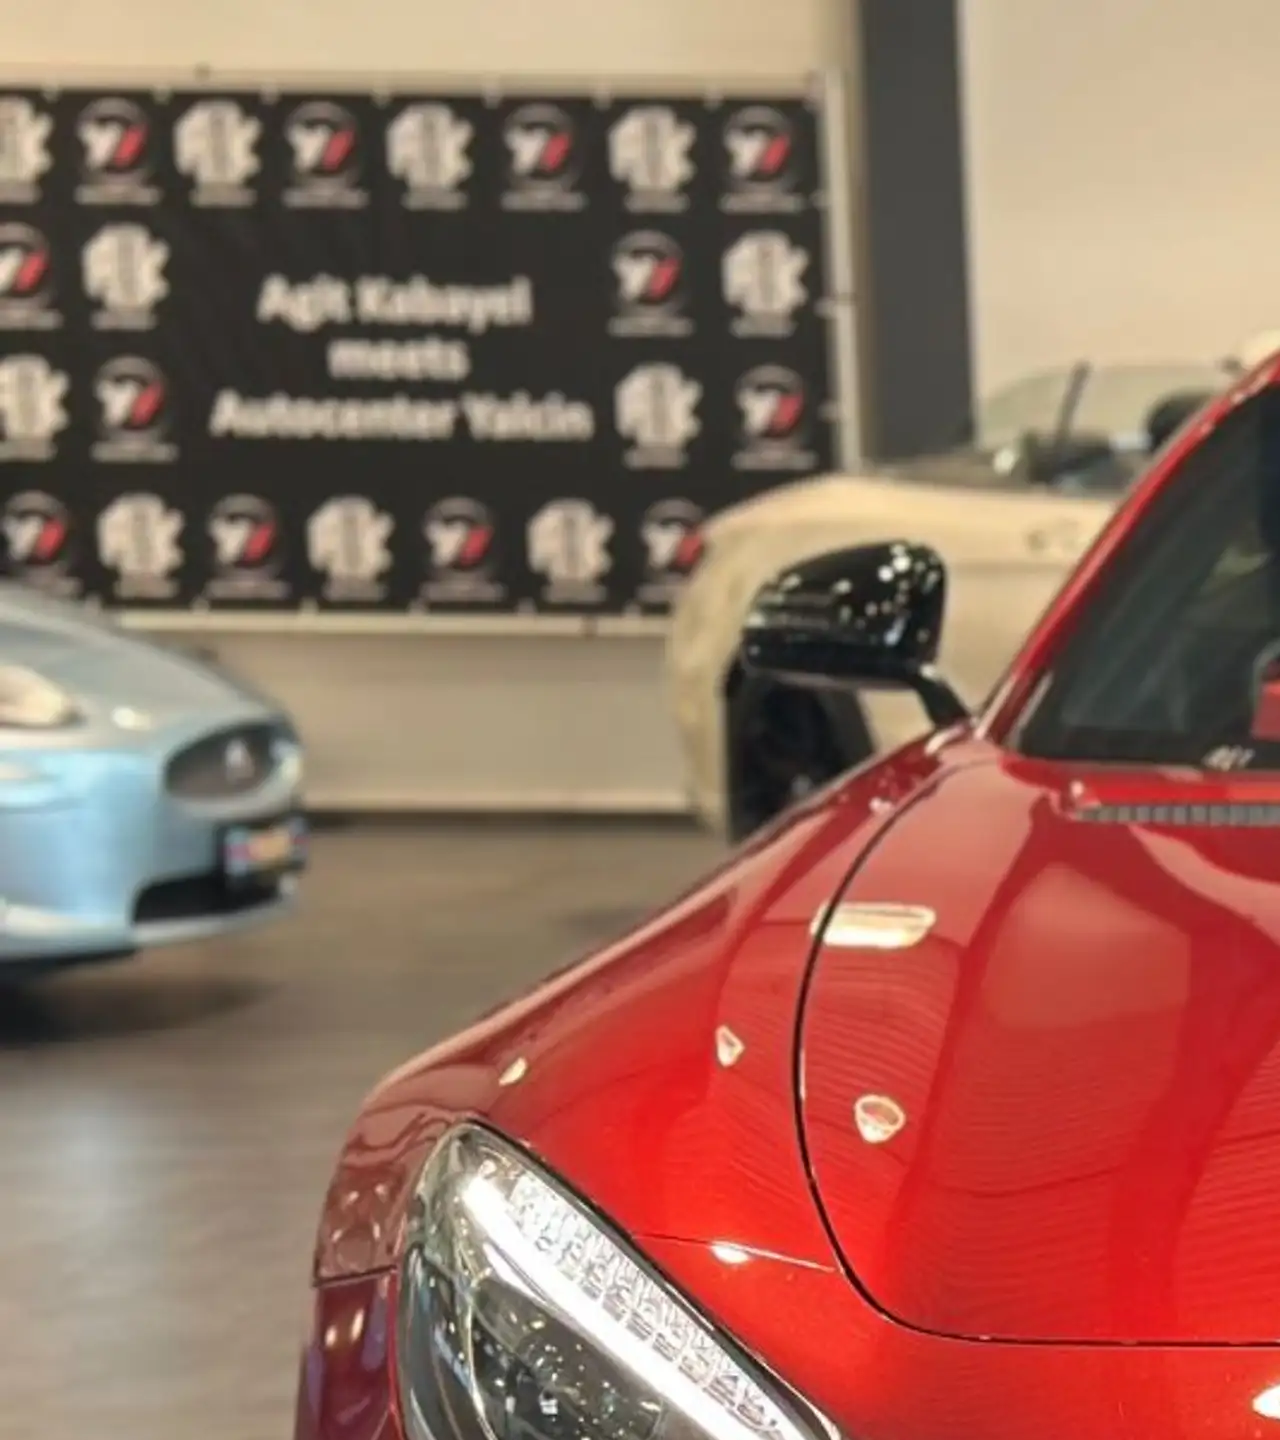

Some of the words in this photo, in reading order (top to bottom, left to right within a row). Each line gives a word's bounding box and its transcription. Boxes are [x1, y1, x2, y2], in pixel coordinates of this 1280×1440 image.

[328, 338, 470, 380] meets
[210, 390, 456, 439] Autocenter
[462, 391, 594, 440] Yalcin
